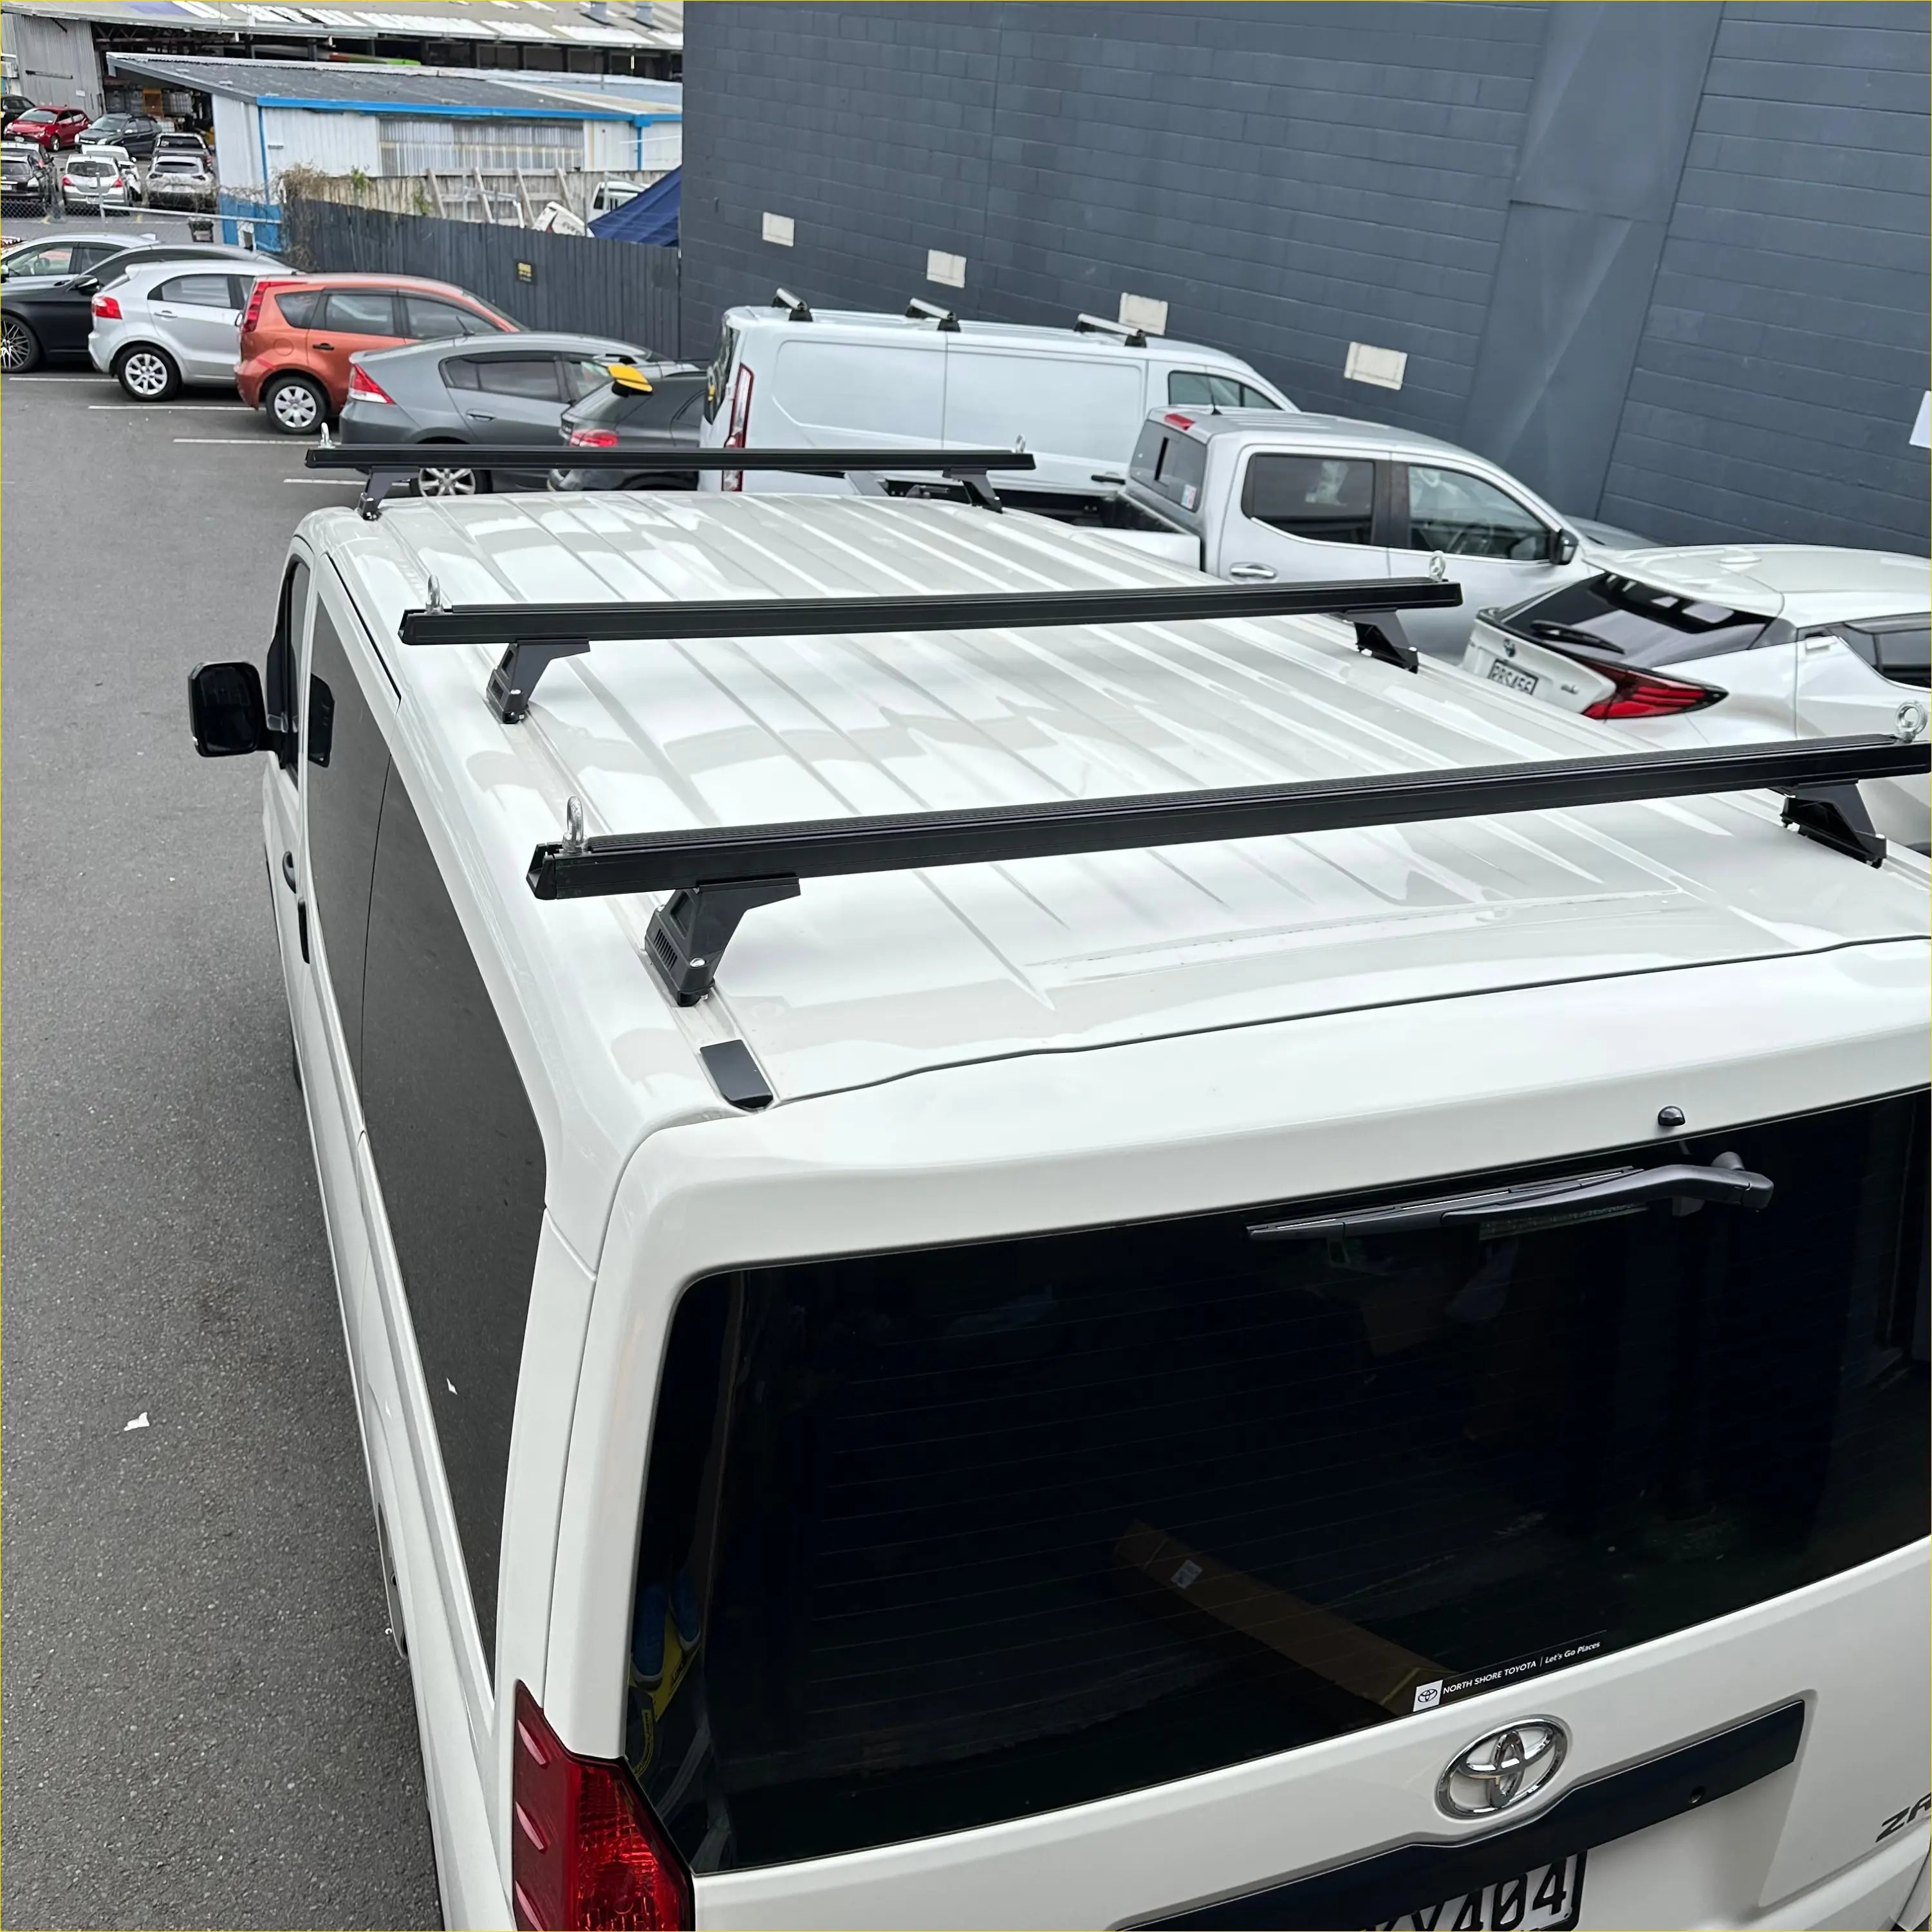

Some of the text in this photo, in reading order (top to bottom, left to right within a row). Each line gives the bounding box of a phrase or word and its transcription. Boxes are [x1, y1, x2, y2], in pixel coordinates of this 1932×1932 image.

[1442, 1679, 1473, 1695] NORTH
[1474, 1670, 1503, 1685] SHORE
[1504, 1660, 1537, 1676] TOYOTA
[1545, 1653, 1563, 1664] Let's
[1577, 1642, 1601, 1654] Places
